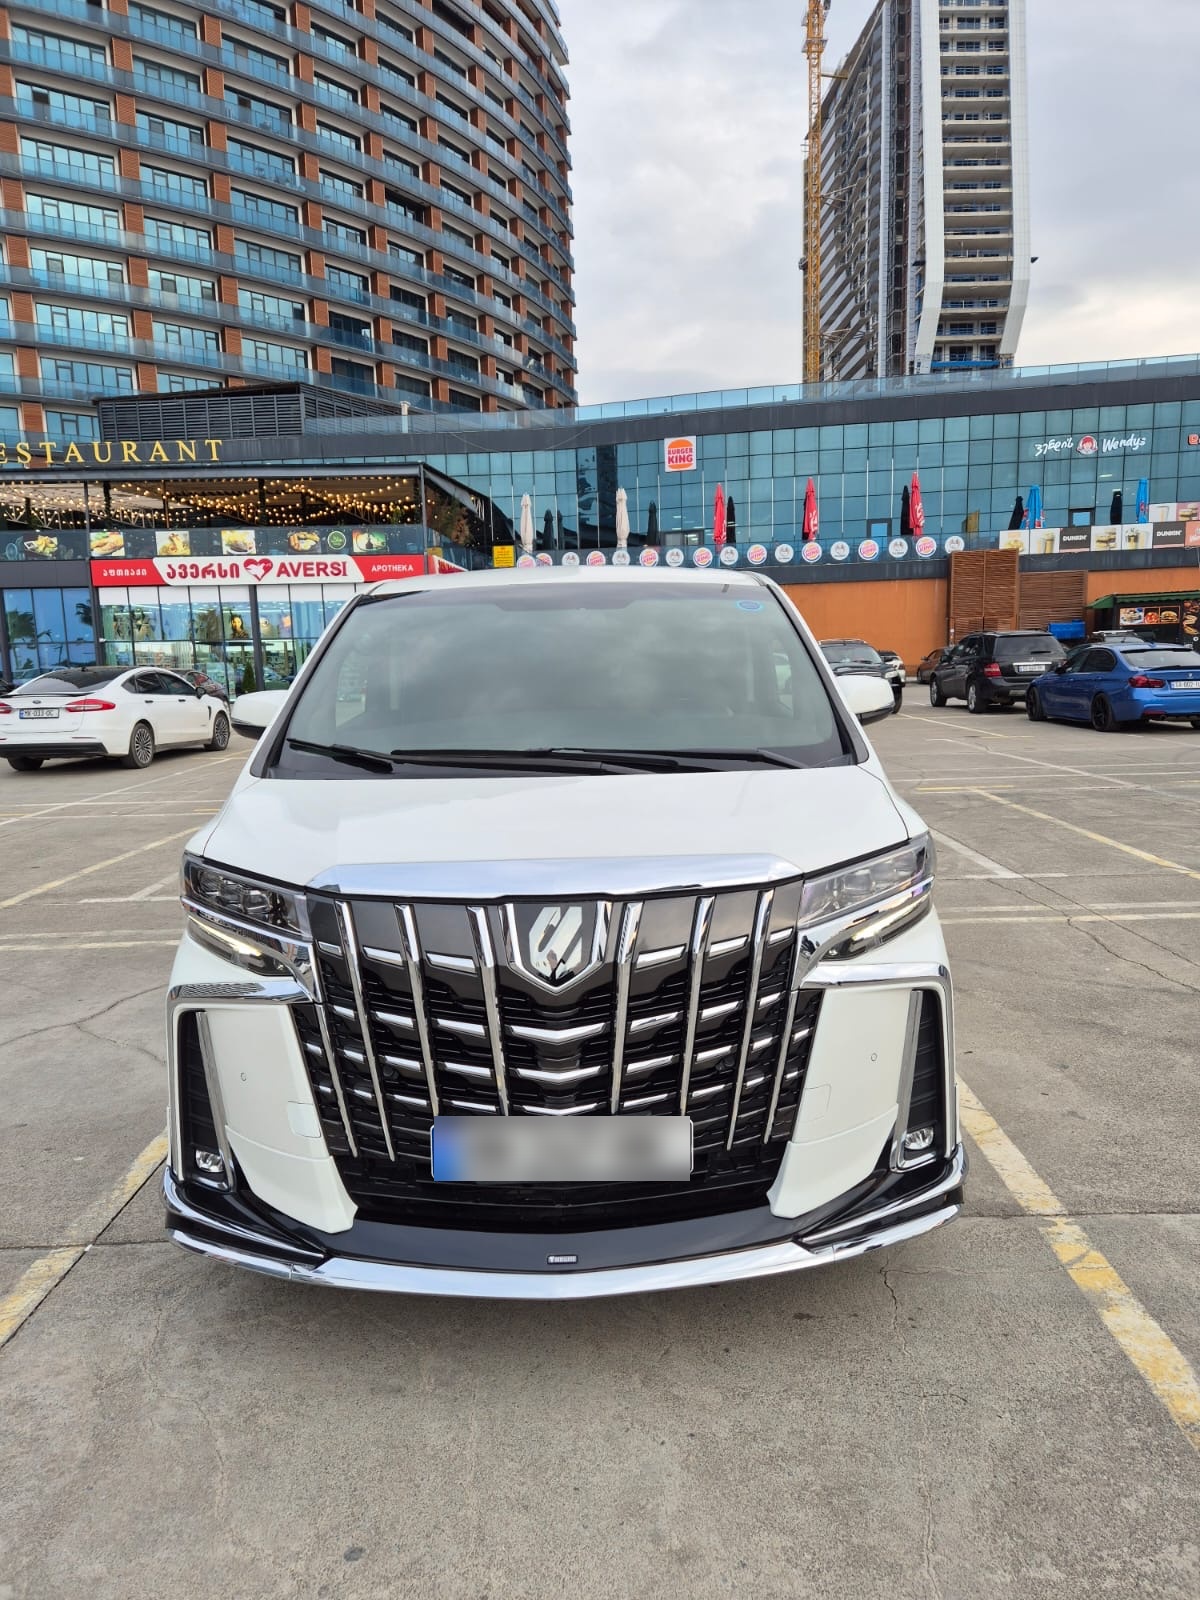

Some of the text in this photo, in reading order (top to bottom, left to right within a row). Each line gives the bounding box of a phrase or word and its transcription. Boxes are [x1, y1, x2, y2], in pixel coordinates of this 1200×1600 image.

[667, 455, 693, 464] KING
[166, 562, 240, 580] ავერსი
[276, 561, 349, 578] AVERSI
[371, 564, 414, 573] APOTHEKA
